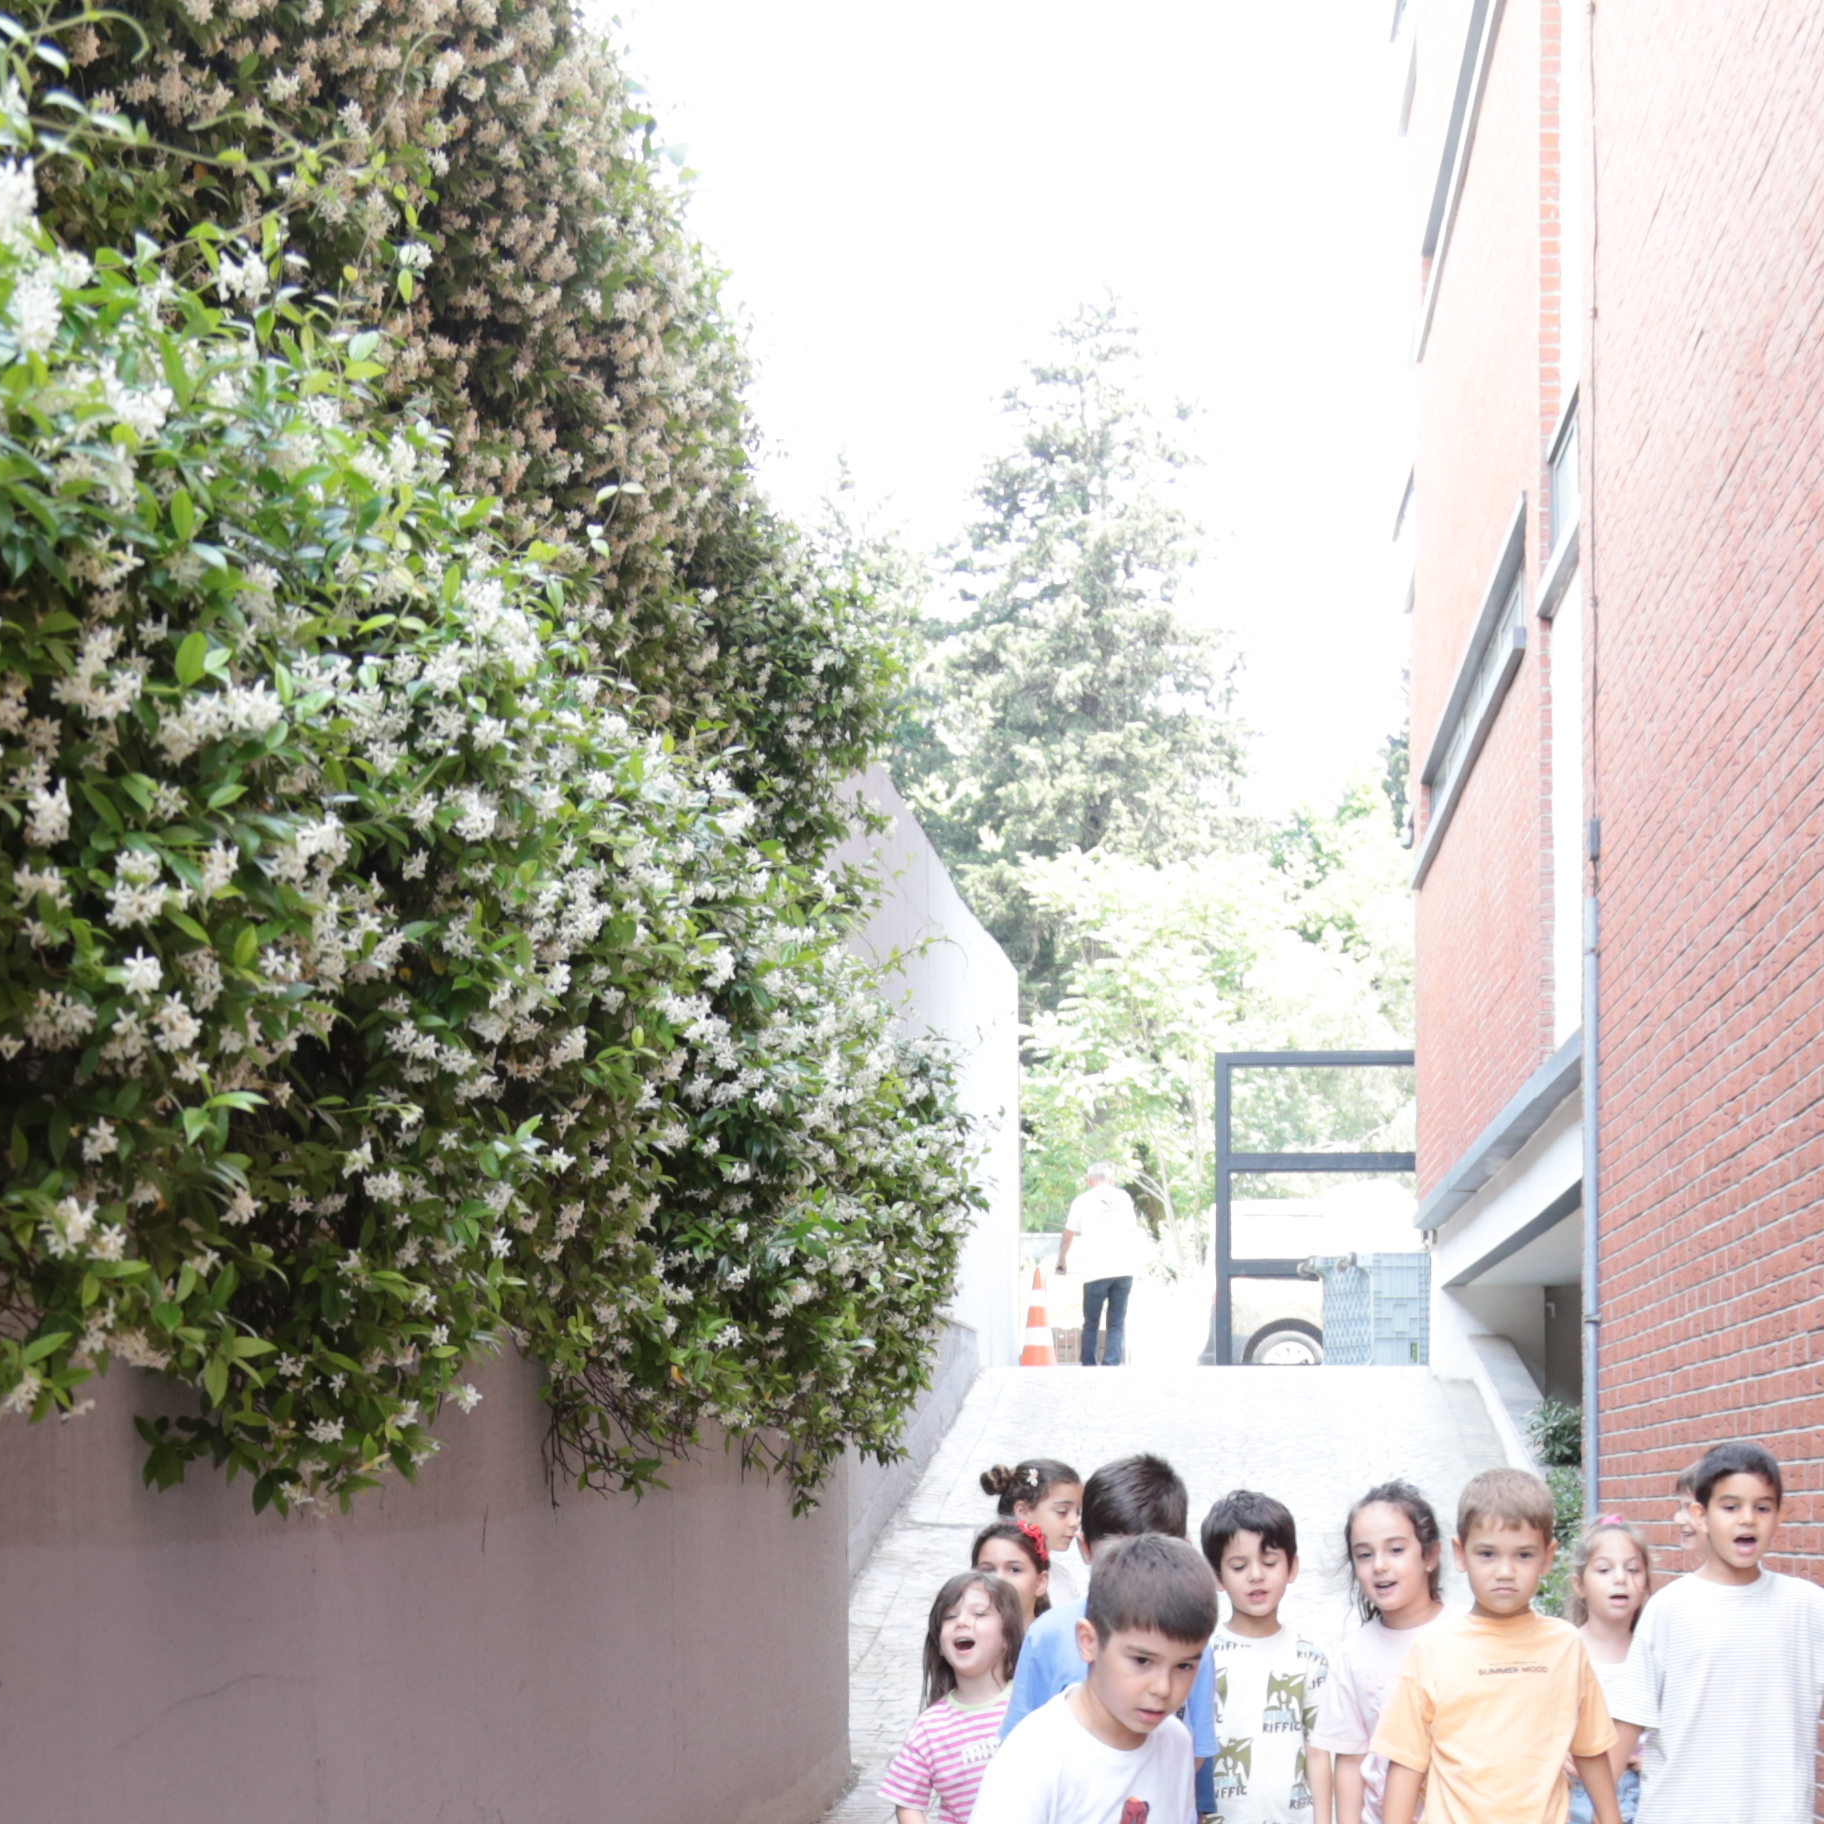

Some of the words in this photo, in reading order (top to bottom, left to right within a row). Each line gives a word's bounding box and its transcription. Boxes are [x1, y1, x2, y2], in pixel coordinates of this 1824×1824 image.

[1478, 1667, 1518, 1675] SUMMER
[1262, 1721, 1302, 1734] RIFFIC
[1215, 1785, 1248, 1799] IFFIC
